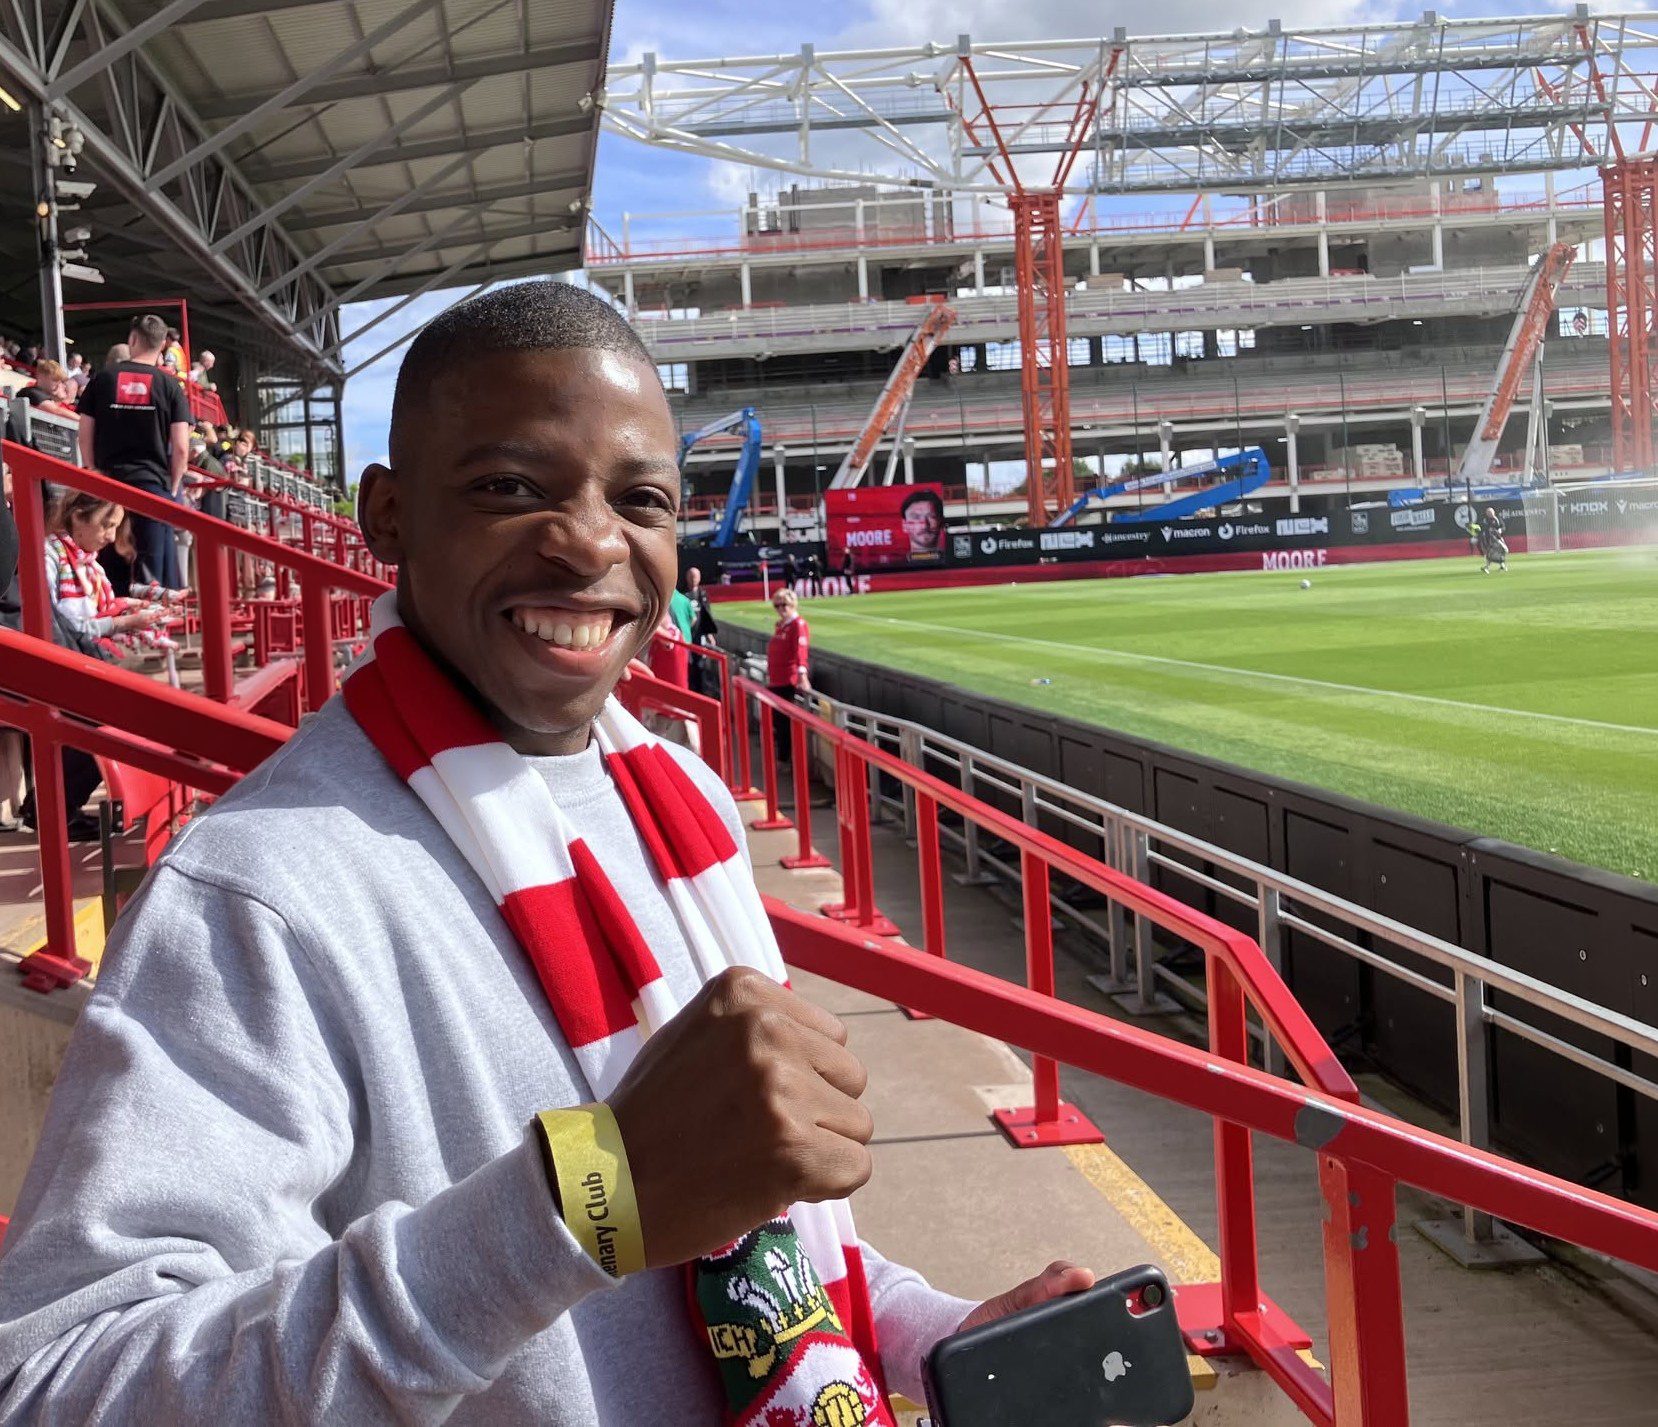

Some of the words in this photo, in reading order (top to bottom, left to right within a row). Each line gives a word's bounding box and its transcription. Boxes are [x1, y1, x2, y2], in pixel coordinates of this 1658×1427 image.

[1173, 527, 1211, 539] macron
[1235, 523, 1270, 535] Firefox
[846, 529, 893, 547] MOORE
[998, 538, 1034, 550] Firefox
[1262, 549, 1328, 571] MOORE
[581, 1171, 610, 1222] Club
